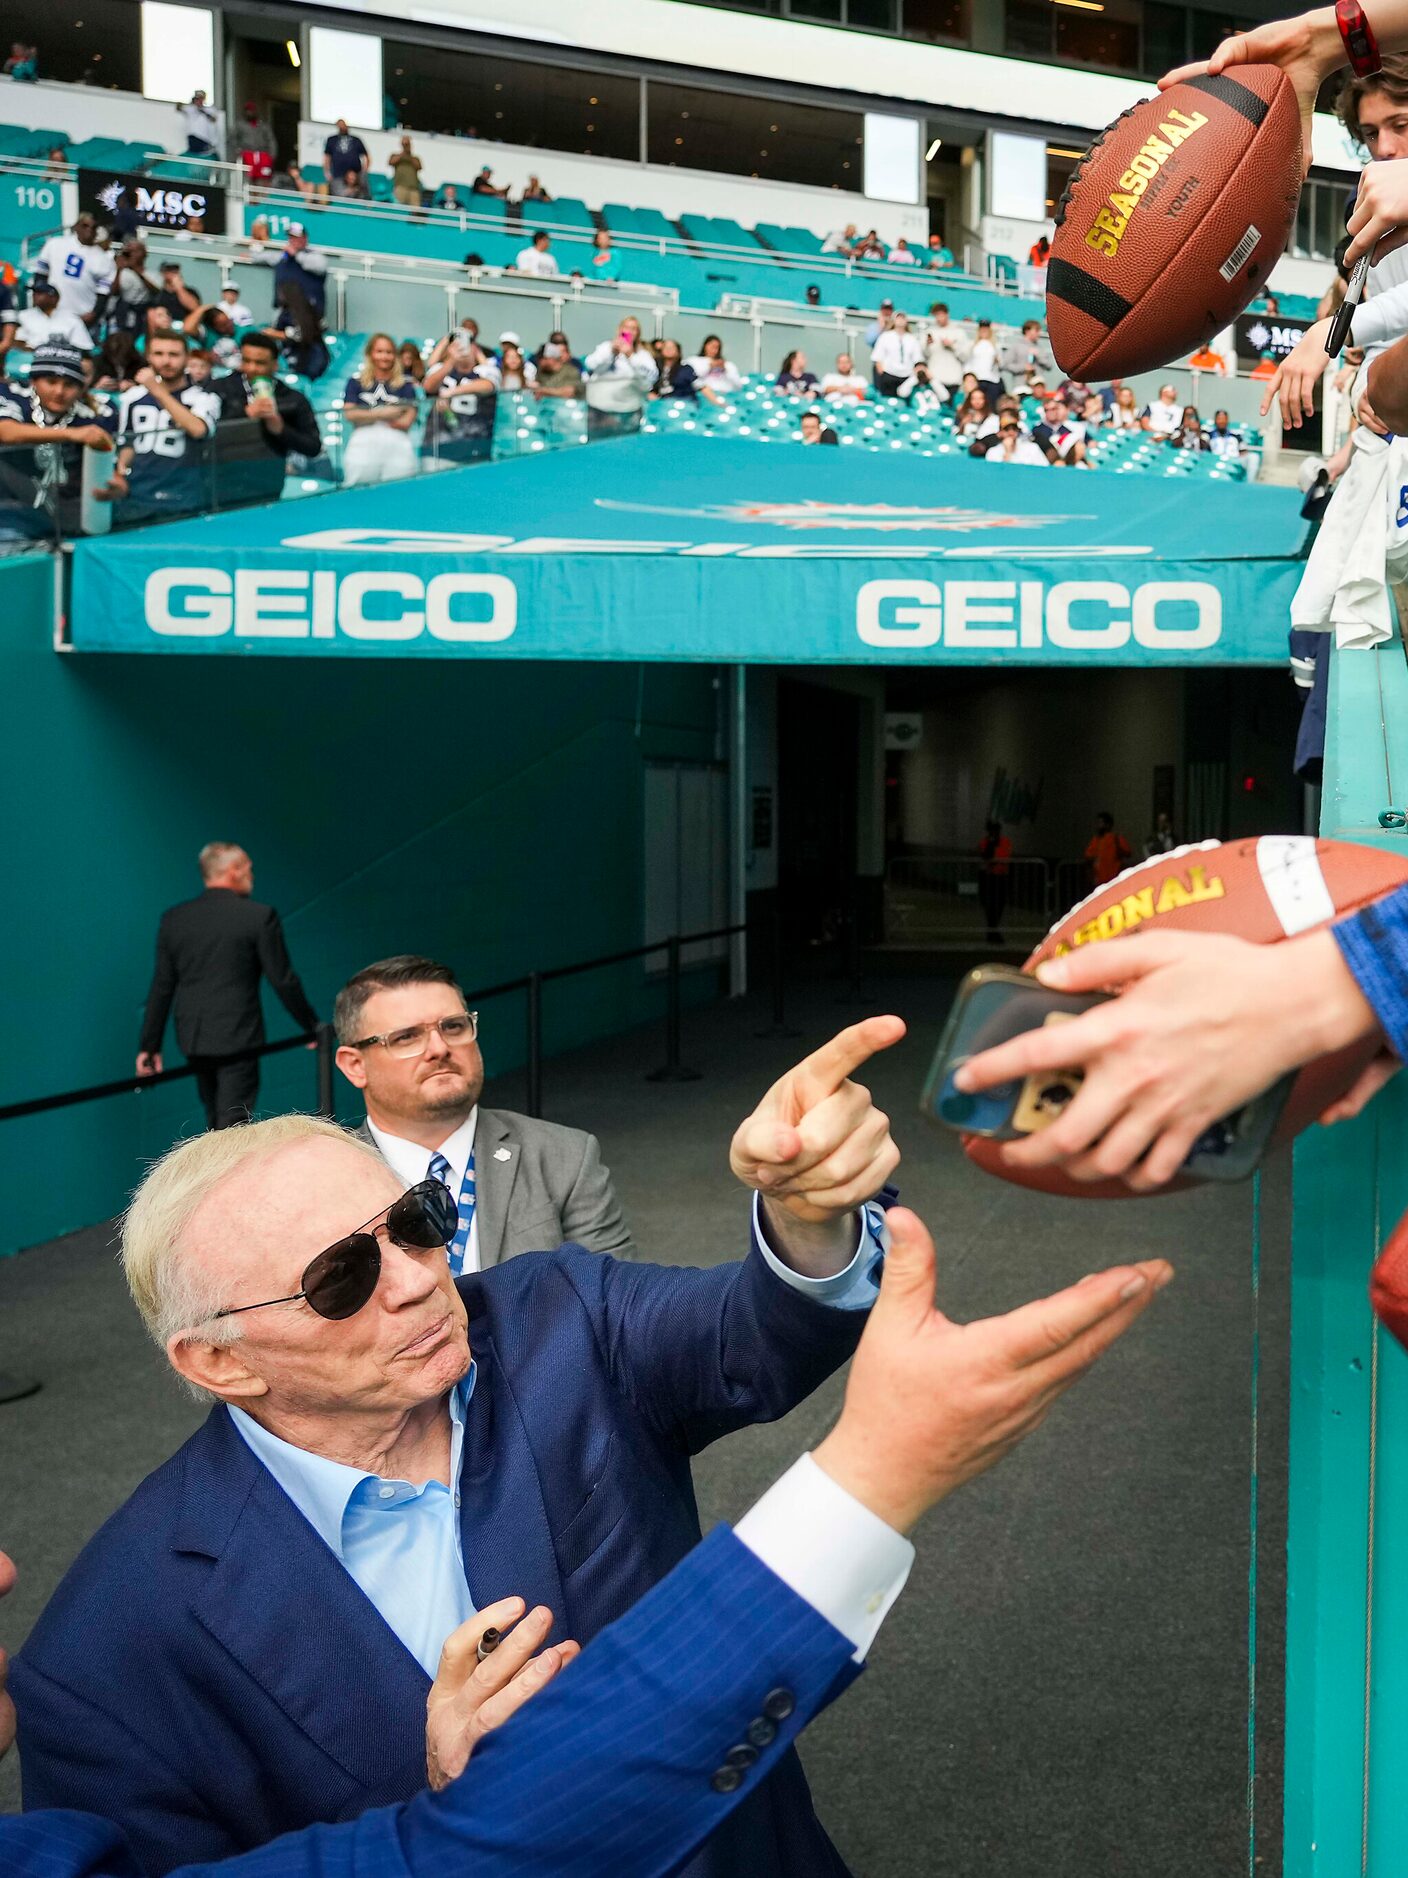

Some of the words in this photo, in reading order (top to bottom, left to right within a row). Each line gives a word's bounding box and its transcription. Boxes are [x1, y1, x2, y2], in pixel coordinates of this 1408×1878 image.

[1084, 108, 1209, 257] SEASONAL
[1166, 175, 1200, 218] YOUTH
[14, 186, 54, 210] 110
[134, 187, 206, 217] MSC
[64, 254, 84, 278] 9
[1270, 326, 1306, 348] MS
[280, 529, 1154, 557] GEICO
[144, 567, 518, 642] GEICO
[856, 578, 1222, 650] GEICO
